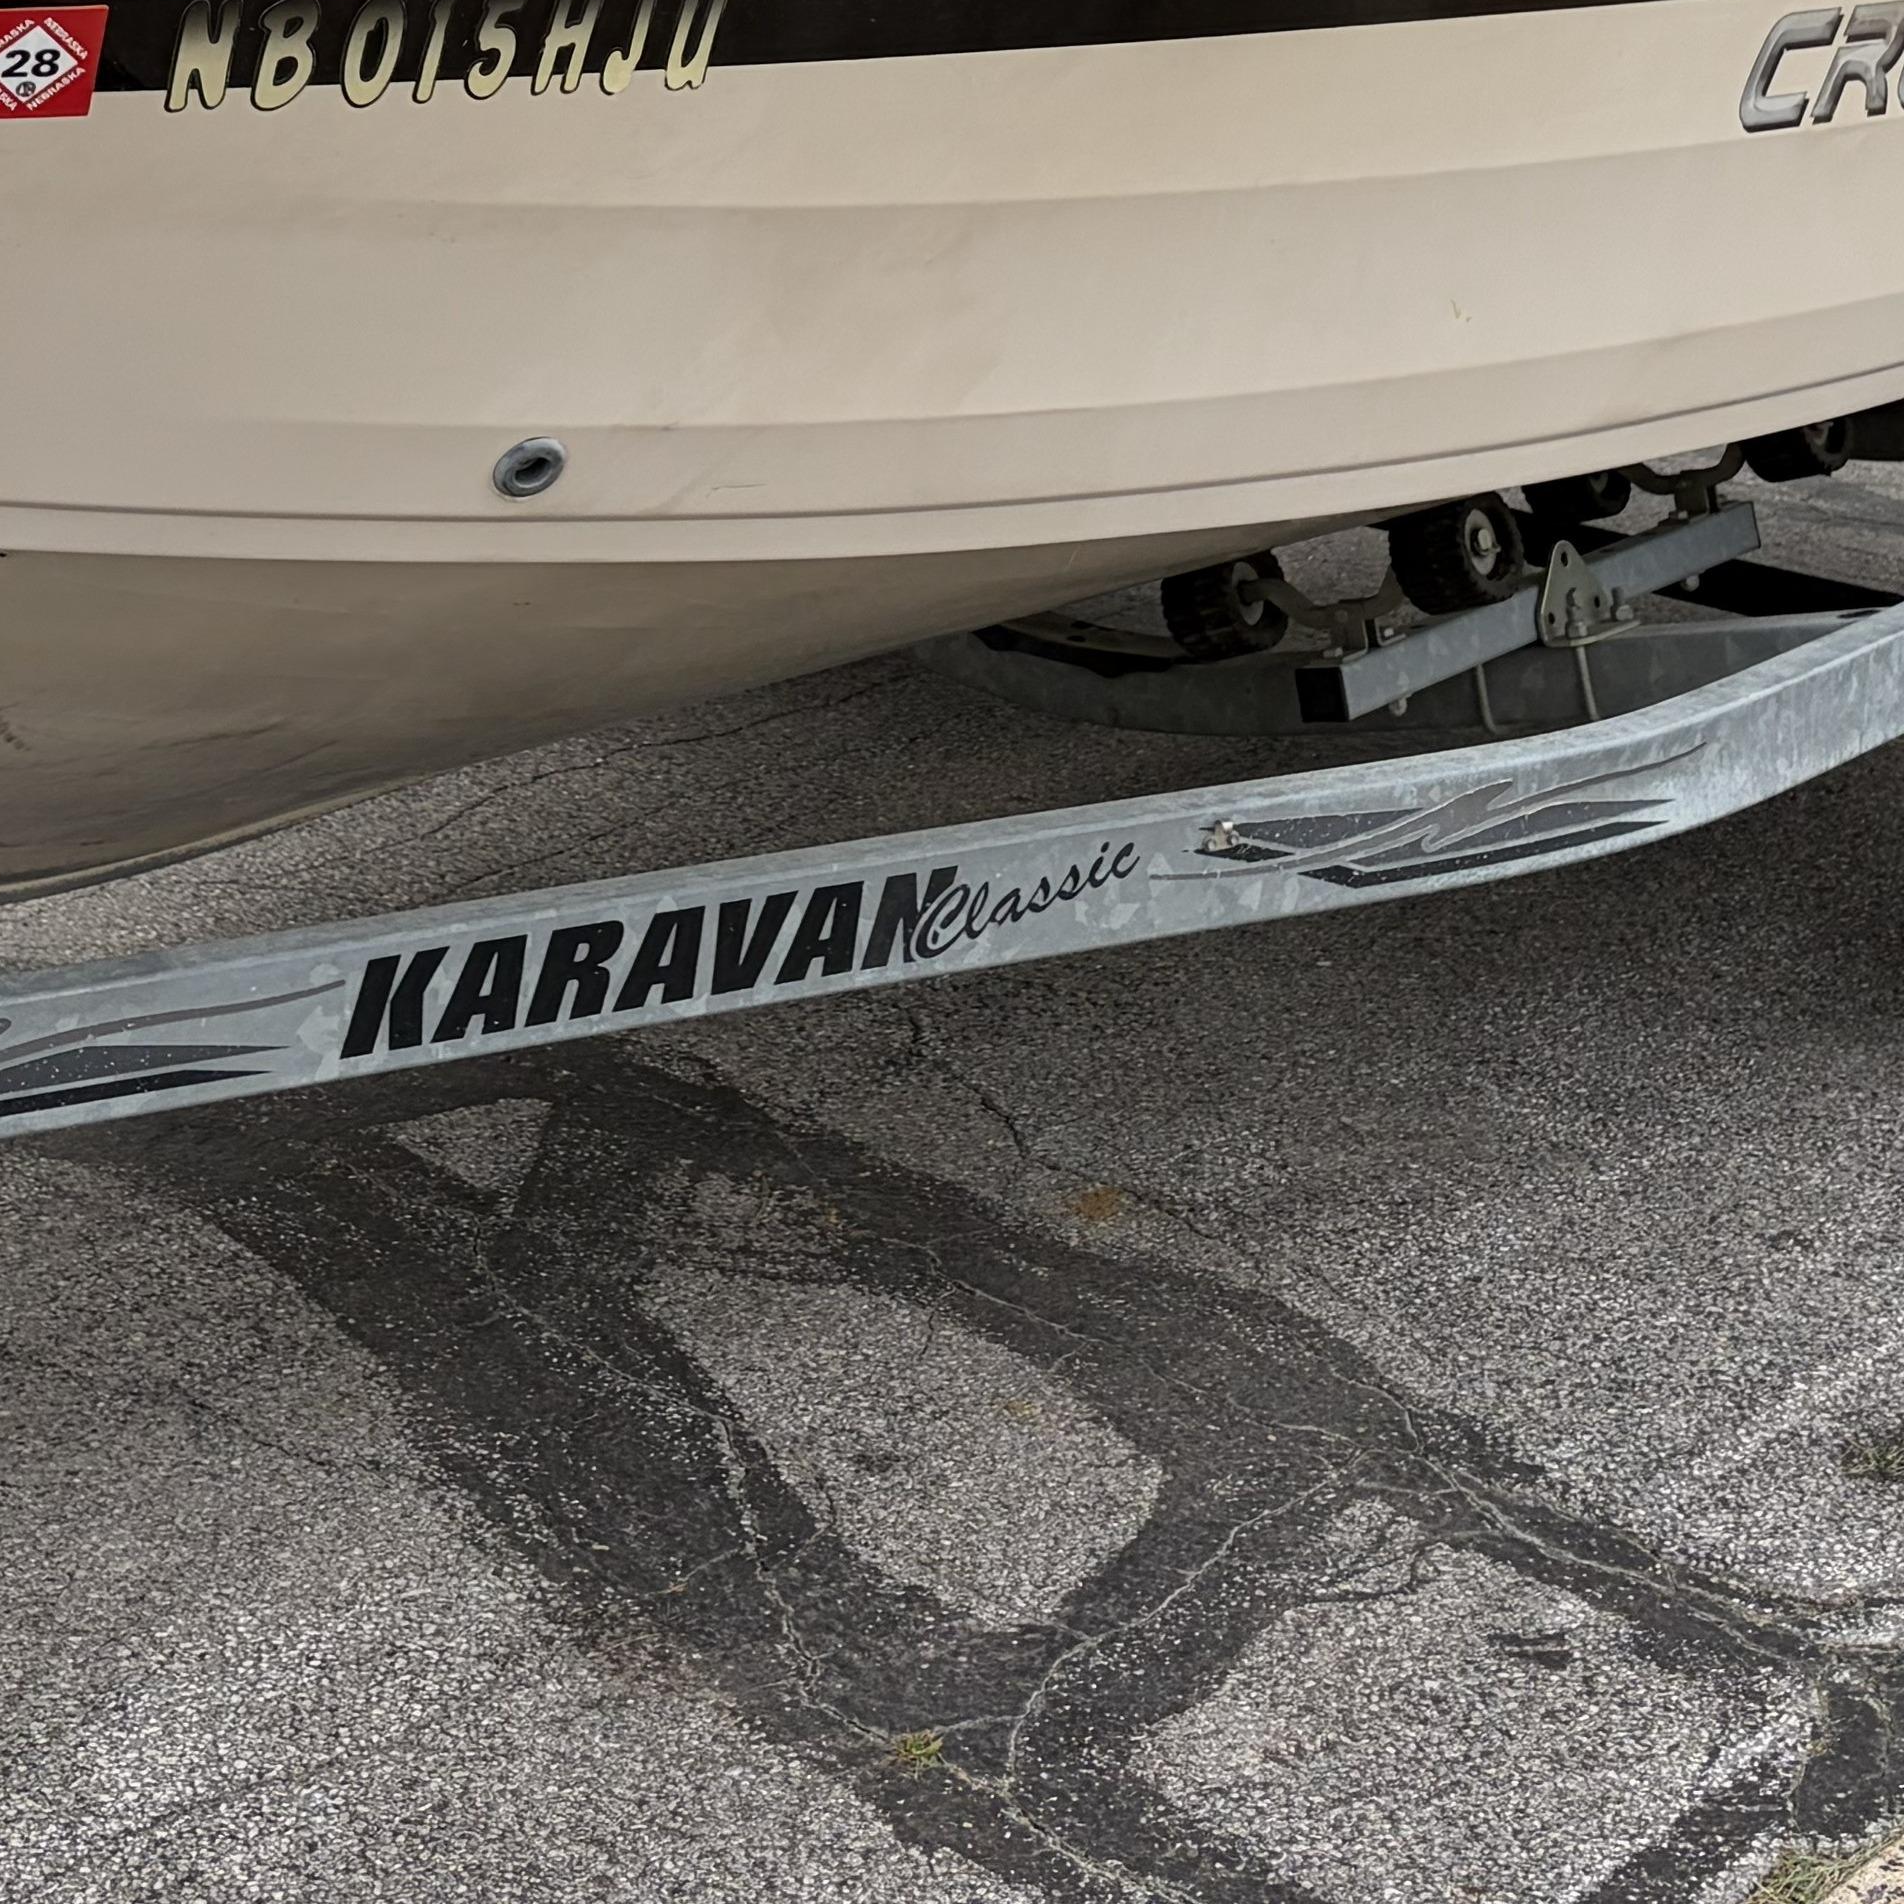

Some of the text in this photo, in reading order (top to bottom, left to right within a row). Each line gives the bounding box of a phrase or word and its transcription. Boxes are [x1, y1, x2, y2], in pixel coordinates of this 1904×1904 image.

[0, 48, 61, 79] 28
[25, 66, 87, 112] NEBRASKA
[339, 840, 1142, 1061] KARAVAN Classic
